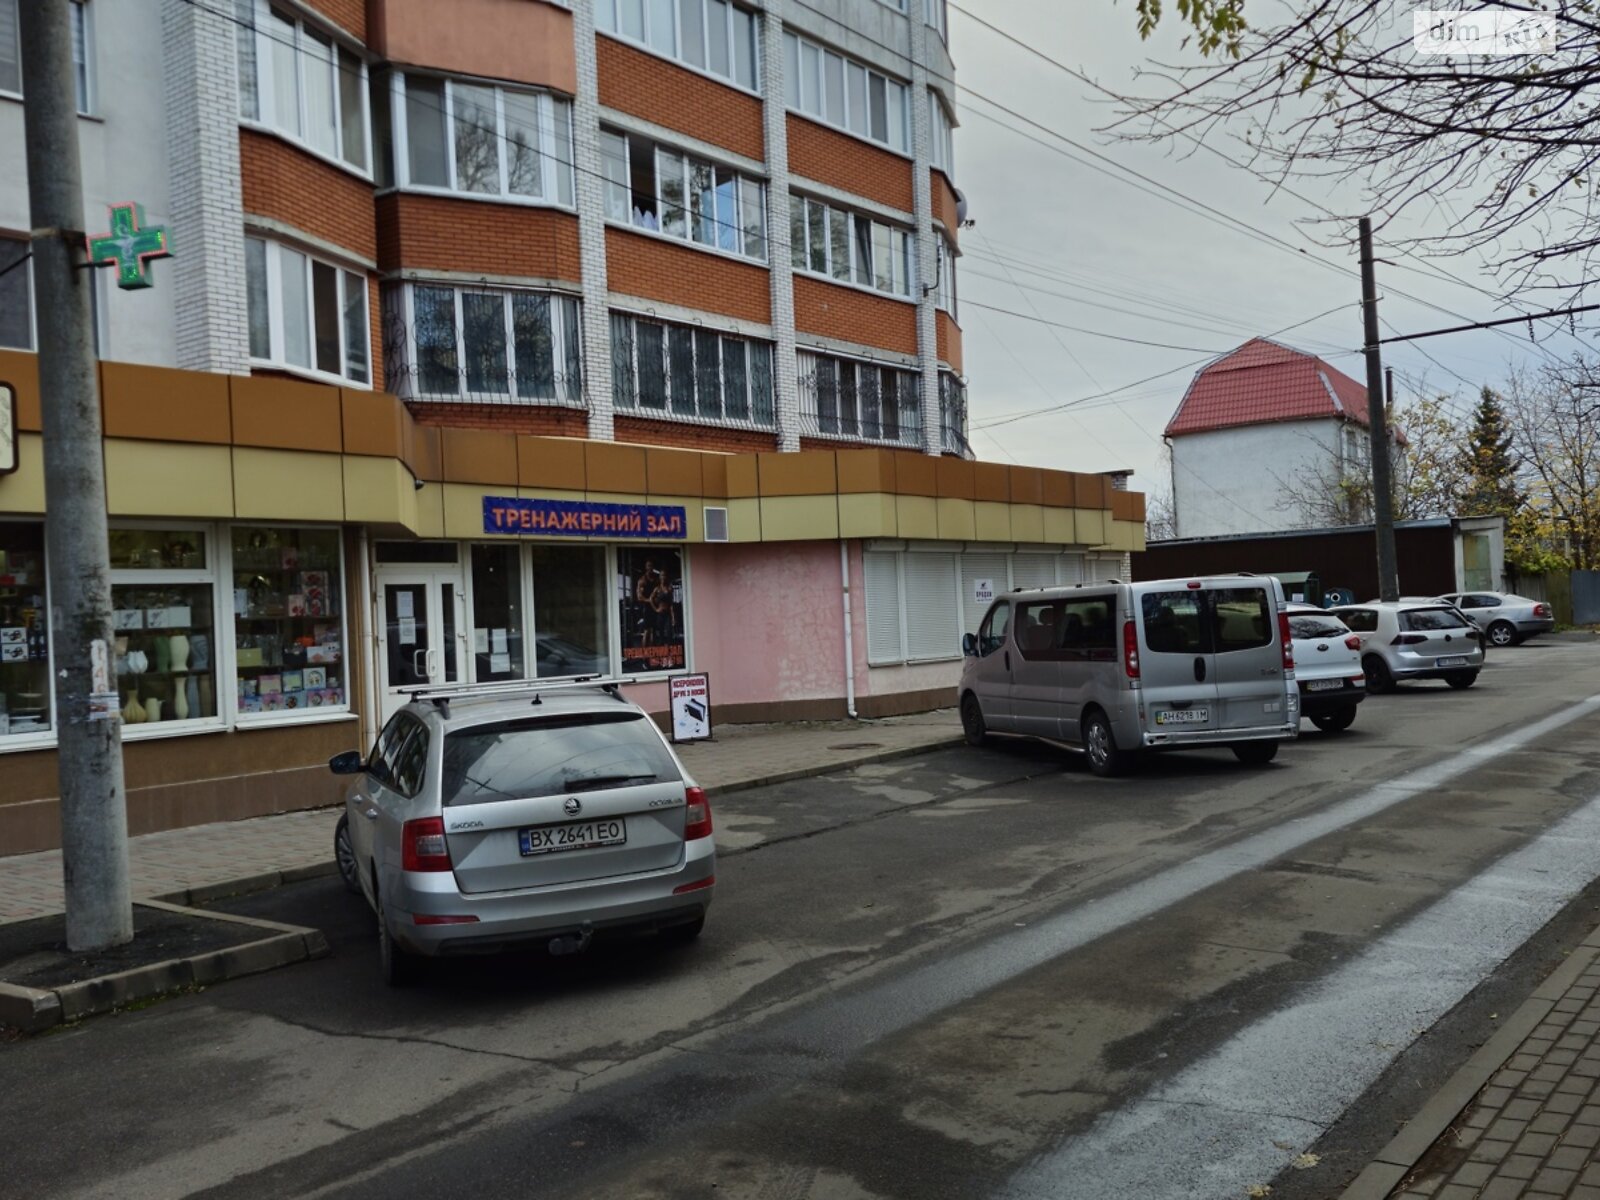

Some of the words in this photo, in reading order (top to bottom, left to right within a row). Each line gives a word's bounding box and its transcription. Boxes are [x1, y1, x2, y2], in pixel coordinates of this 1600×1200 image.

[492, 507, 642, 532] ТРЕНАЖЕРНИЙ
[647, 515, 682, 533] ЗАЛ
[648, 798, 683, 807] OCTA
[530, 829, 554, 848] BX
[557, 824, 594, 844] 2641
[597, 822, 620, 840] EO
